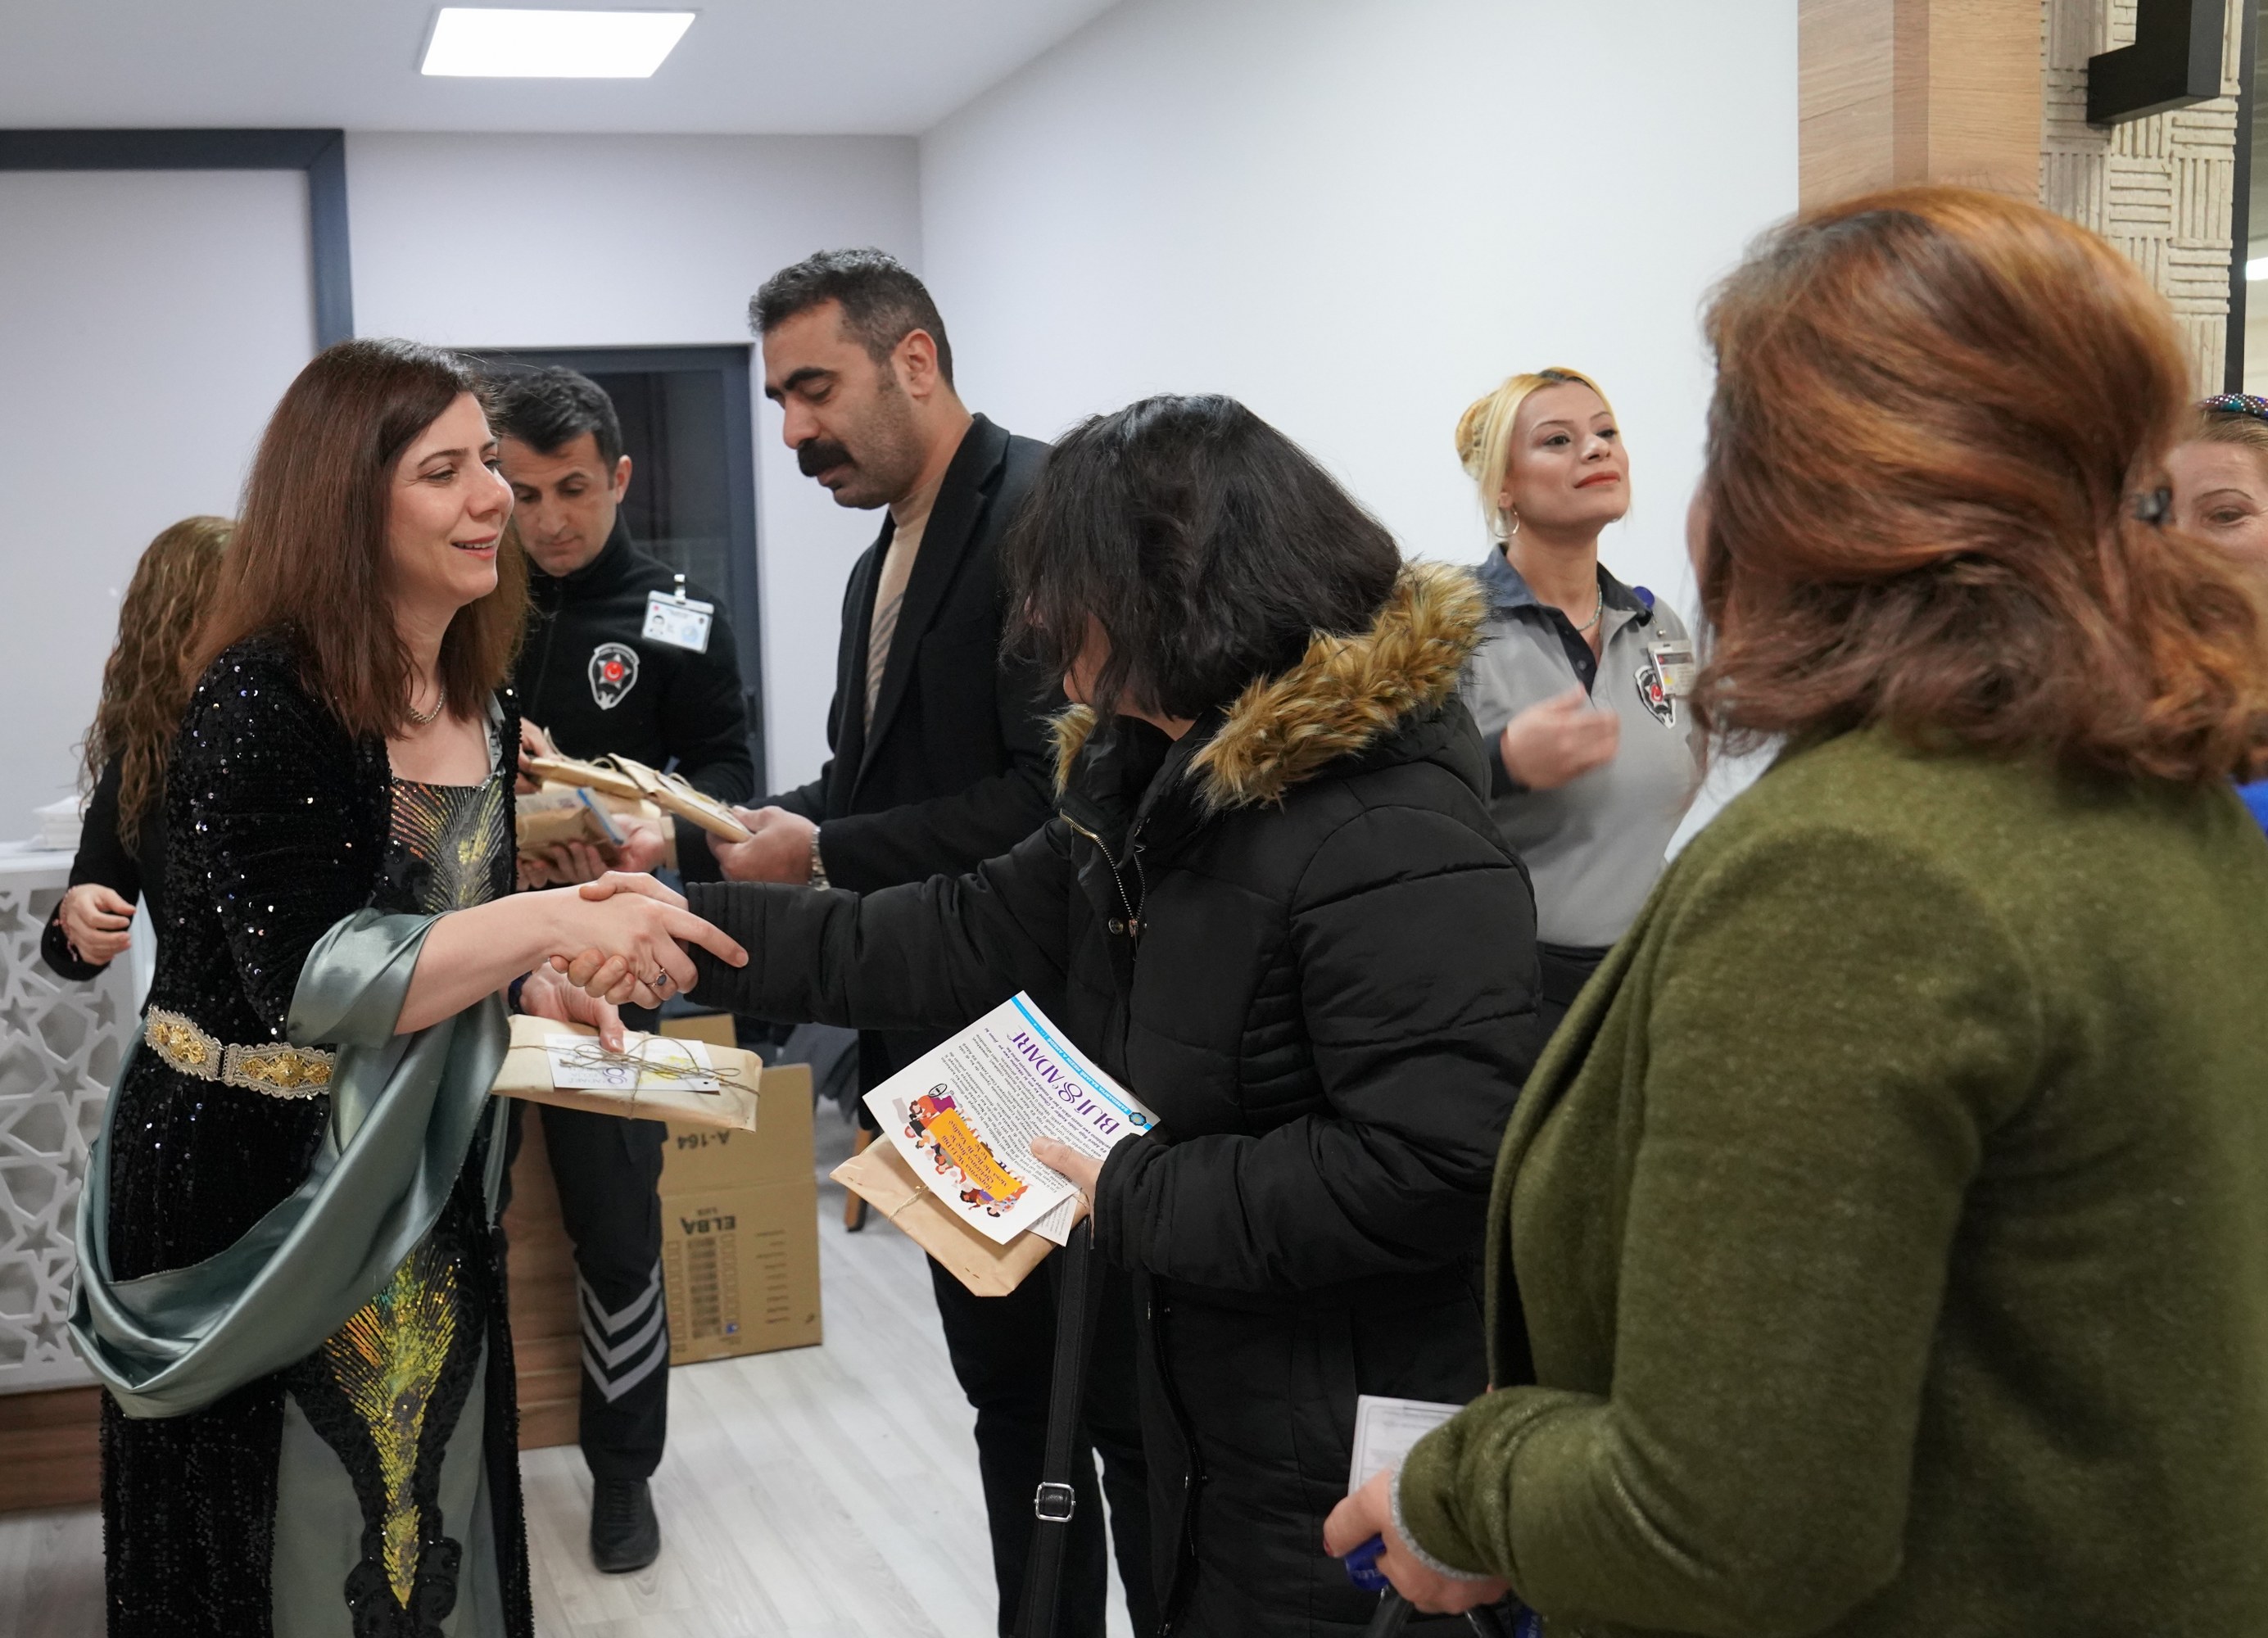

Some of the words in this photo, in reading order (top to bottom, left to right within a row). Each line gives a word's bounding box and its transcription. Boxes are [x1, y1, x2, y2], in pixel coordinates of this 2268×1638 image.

[677, 1130, 730, 1150] A-164
[955, 1154, 965, 1164] Me
[971, 1152, 983, 1165] Ber
[982, 1164, 992, 1173] Me
[680, 1216, 736, 1235] ELBA
